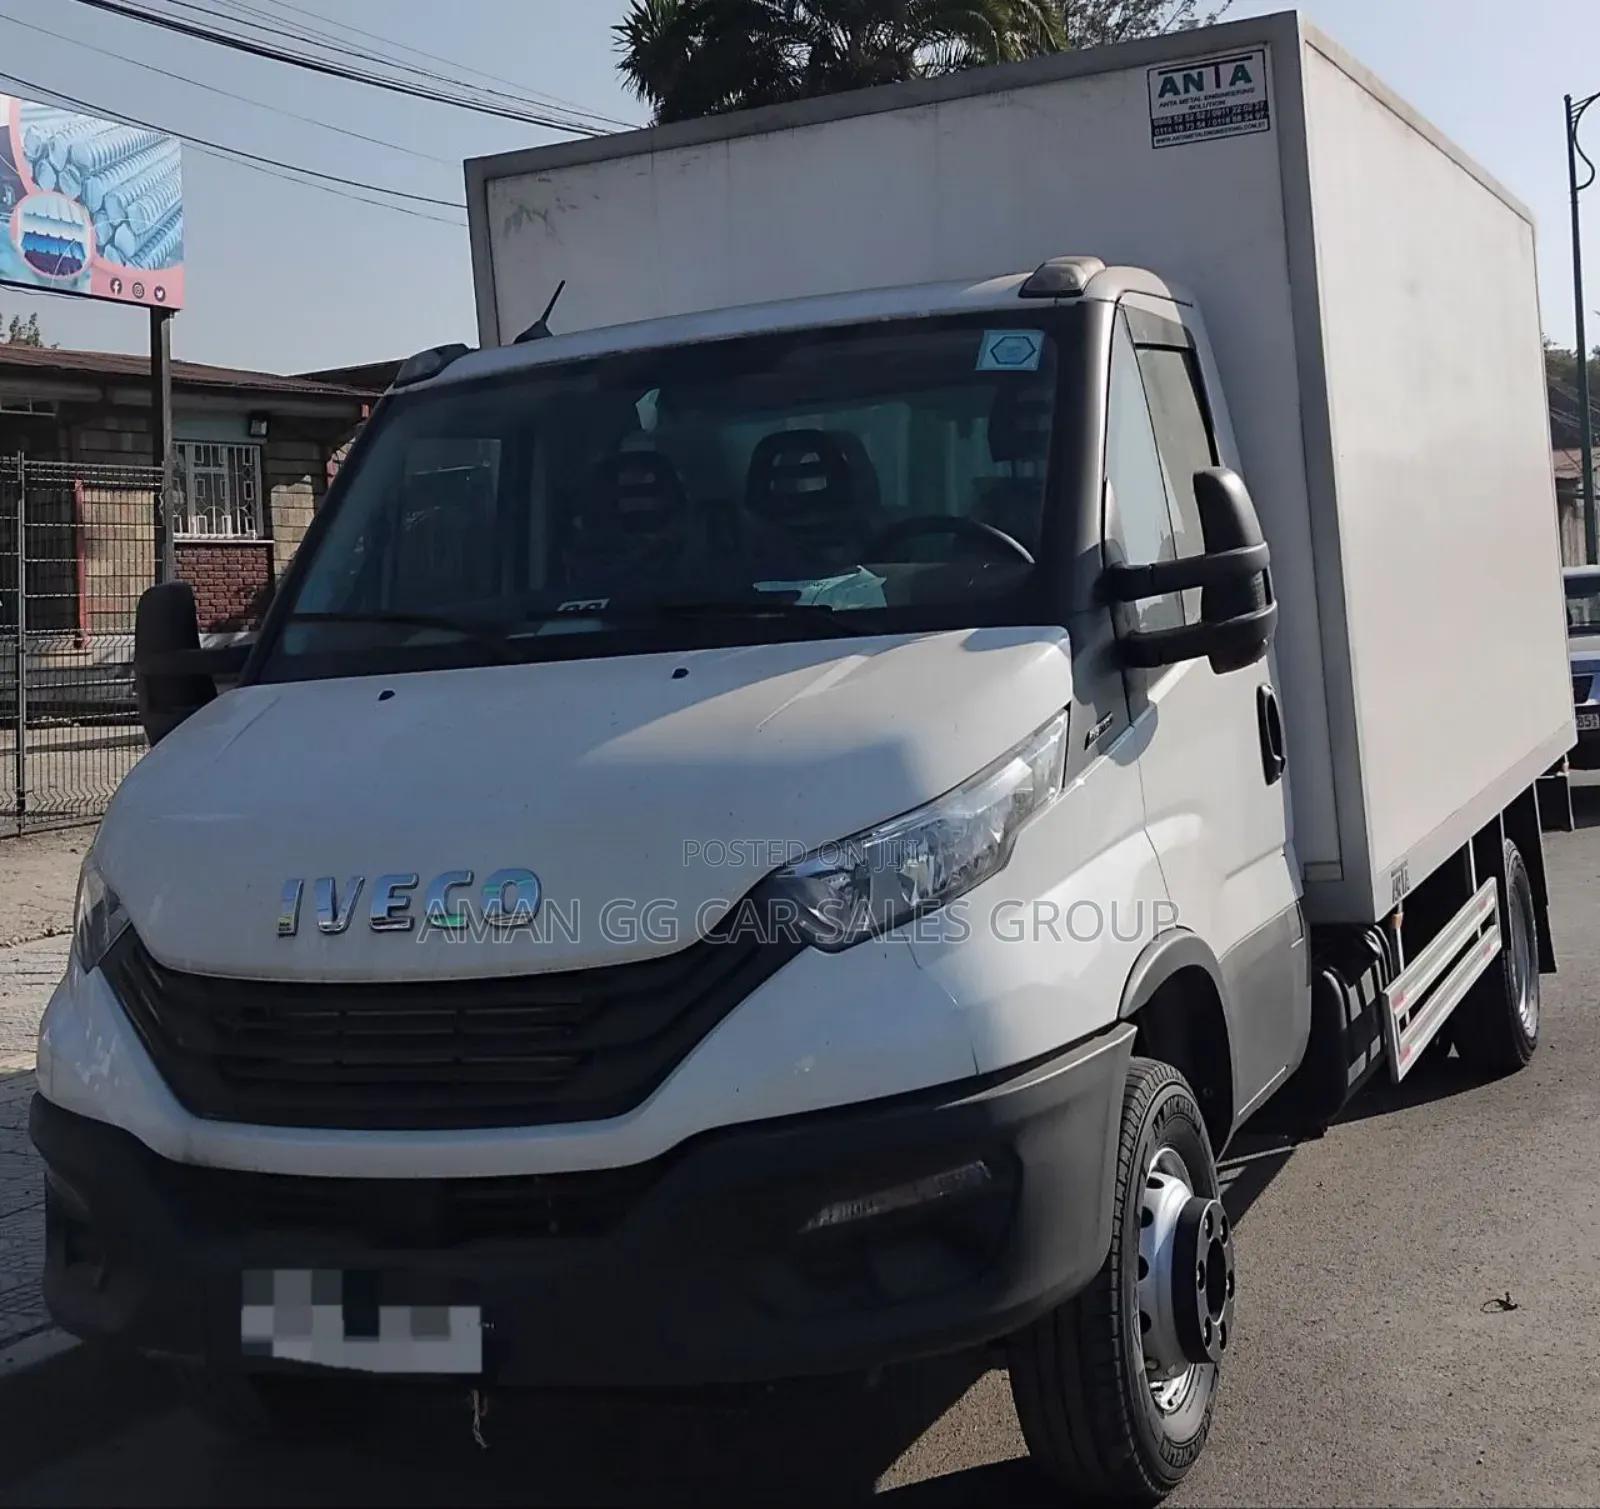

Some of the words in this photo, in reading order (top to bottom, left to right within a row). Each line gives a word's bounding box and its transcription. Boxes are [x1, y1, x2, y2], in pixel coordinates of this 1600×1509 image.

[1158, 55, 1253, 98] ANTA
[1188, 100, 1225, 110] SOLUTION
[277, 868, 541, 937] IVECO
[1163, 1095, 1201, 1129] MICHELIN
